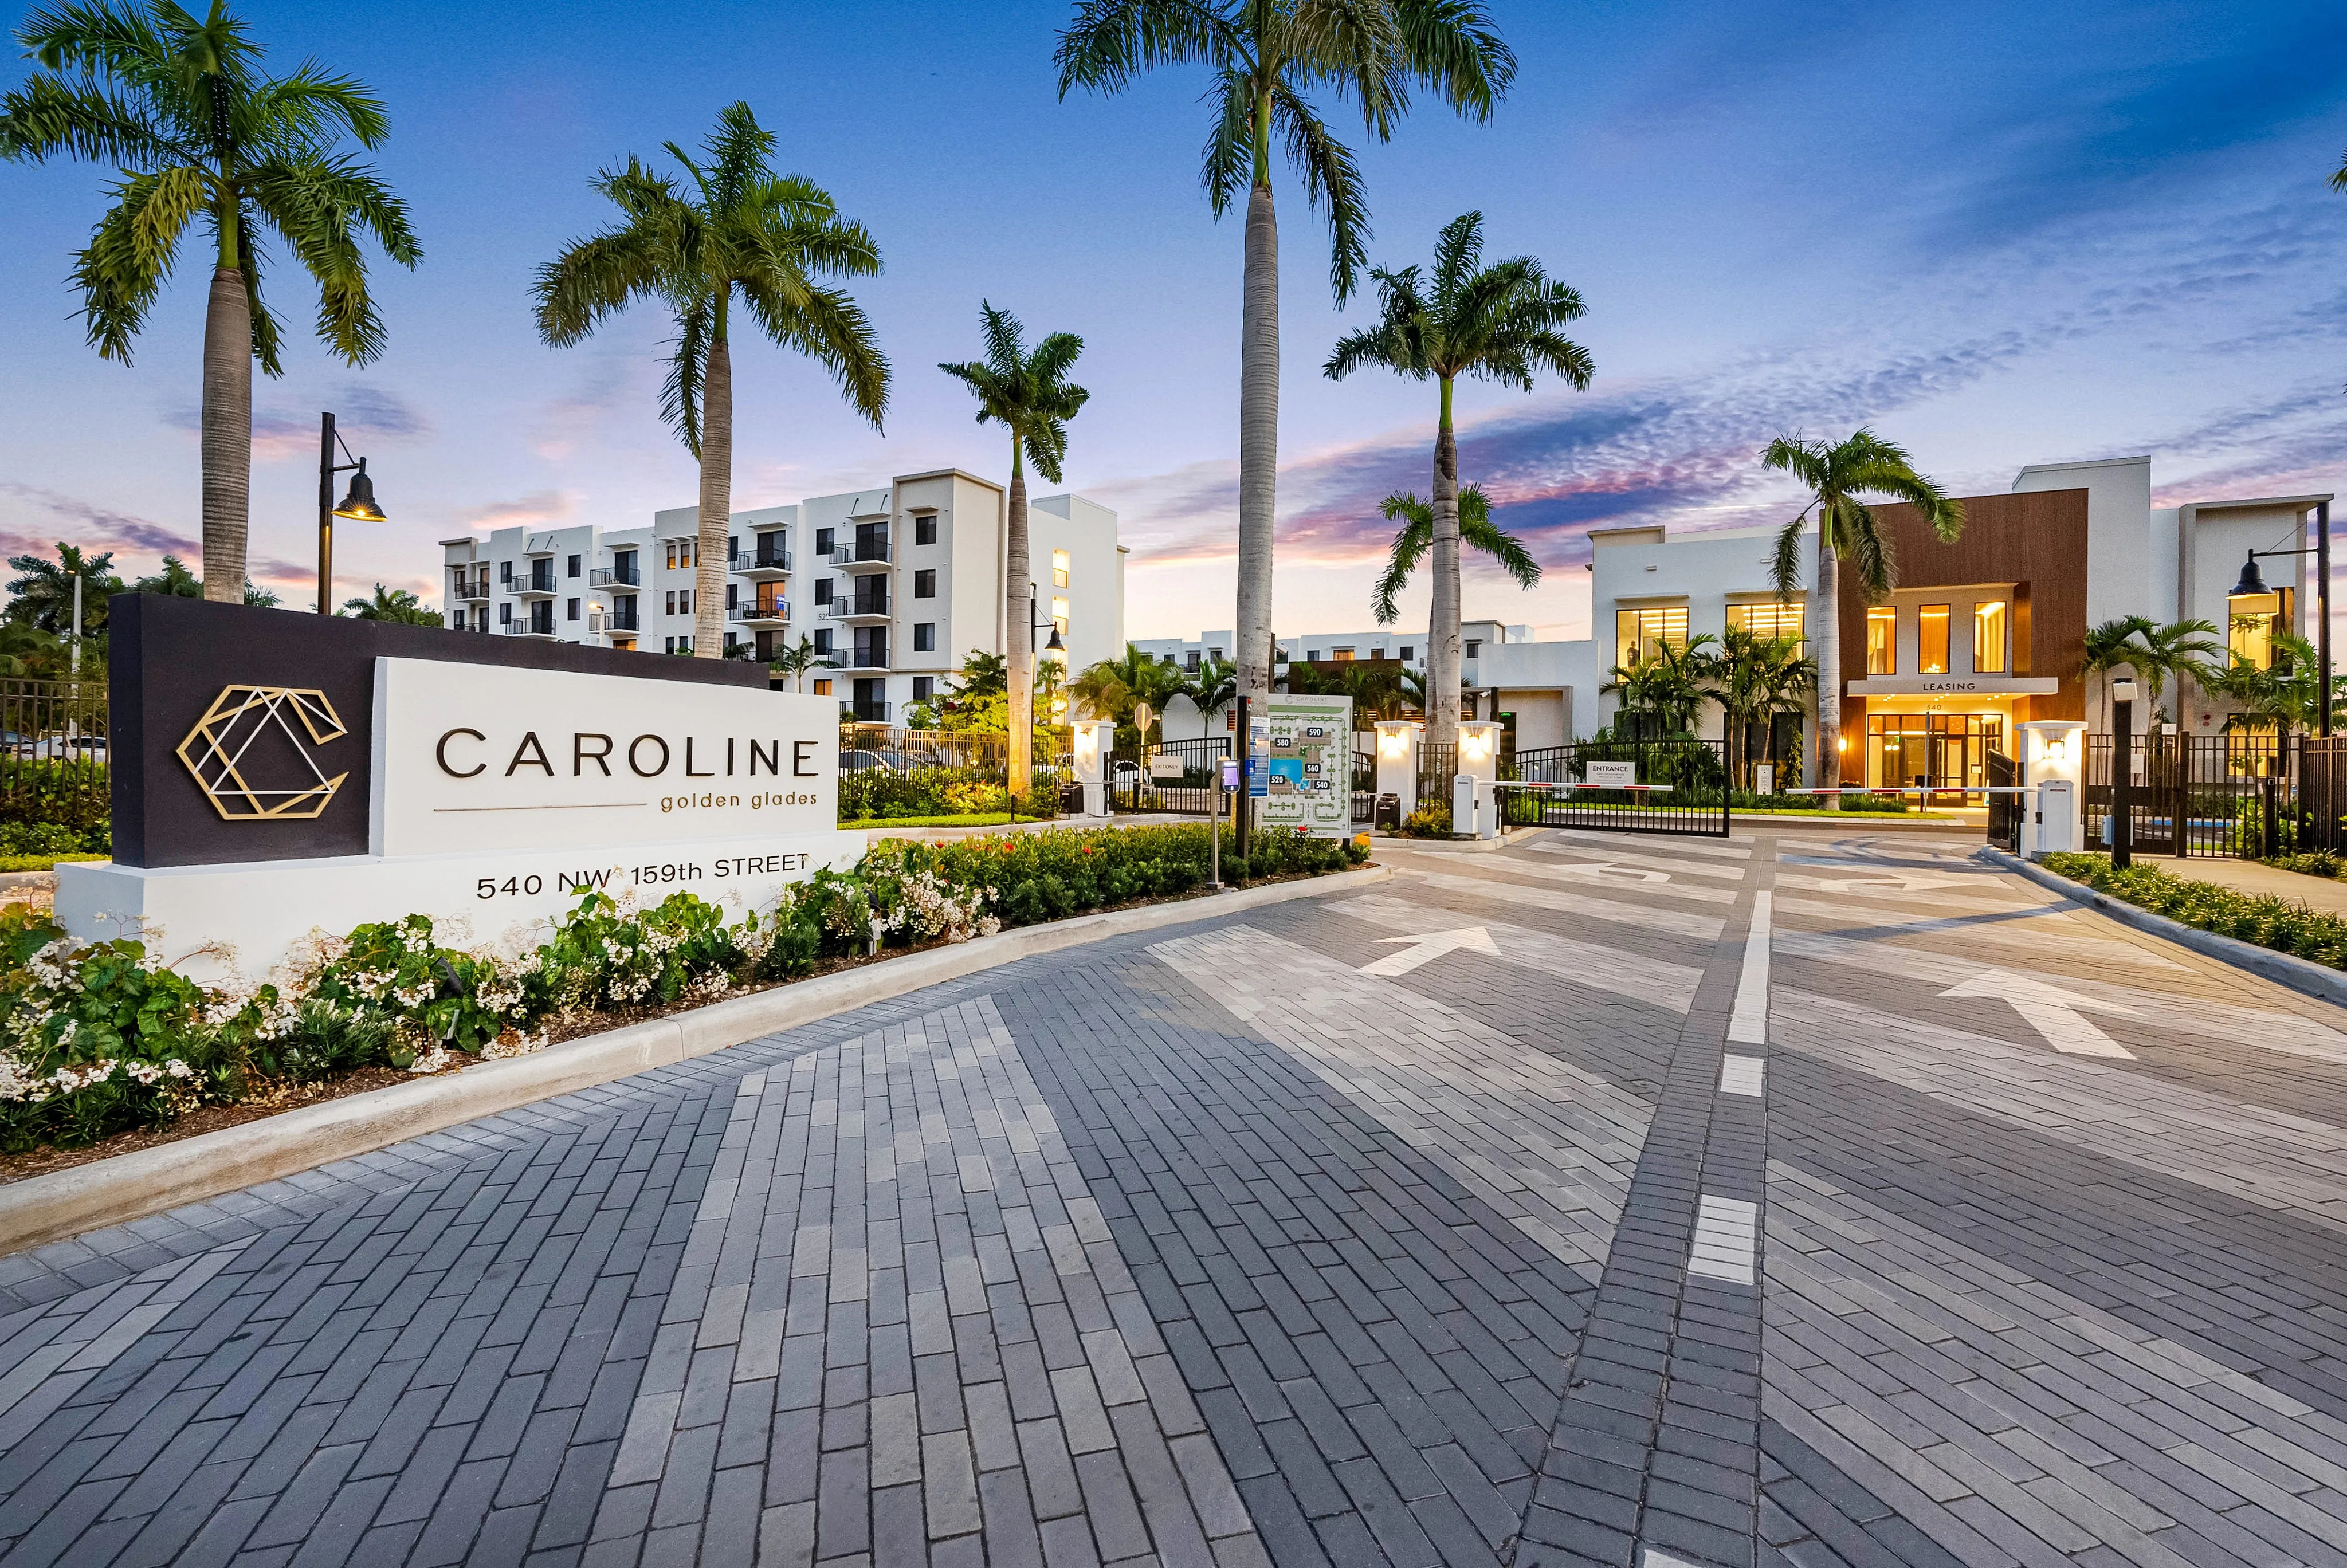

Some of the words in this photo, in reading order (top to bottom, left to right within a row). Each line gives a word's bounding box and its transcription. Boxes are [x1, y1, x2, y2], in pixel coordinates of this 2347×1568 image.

[436, 728, 819, 778] CAROLINE
[661, 792, 740, 813] golden
[751, 791, 817, 809] glades
[477, 875, 543, 899] 540
[558, 869, 612, 892] NW
[631, 862, 702, 885] 159th
[713, 853, 809, 877] STREET
